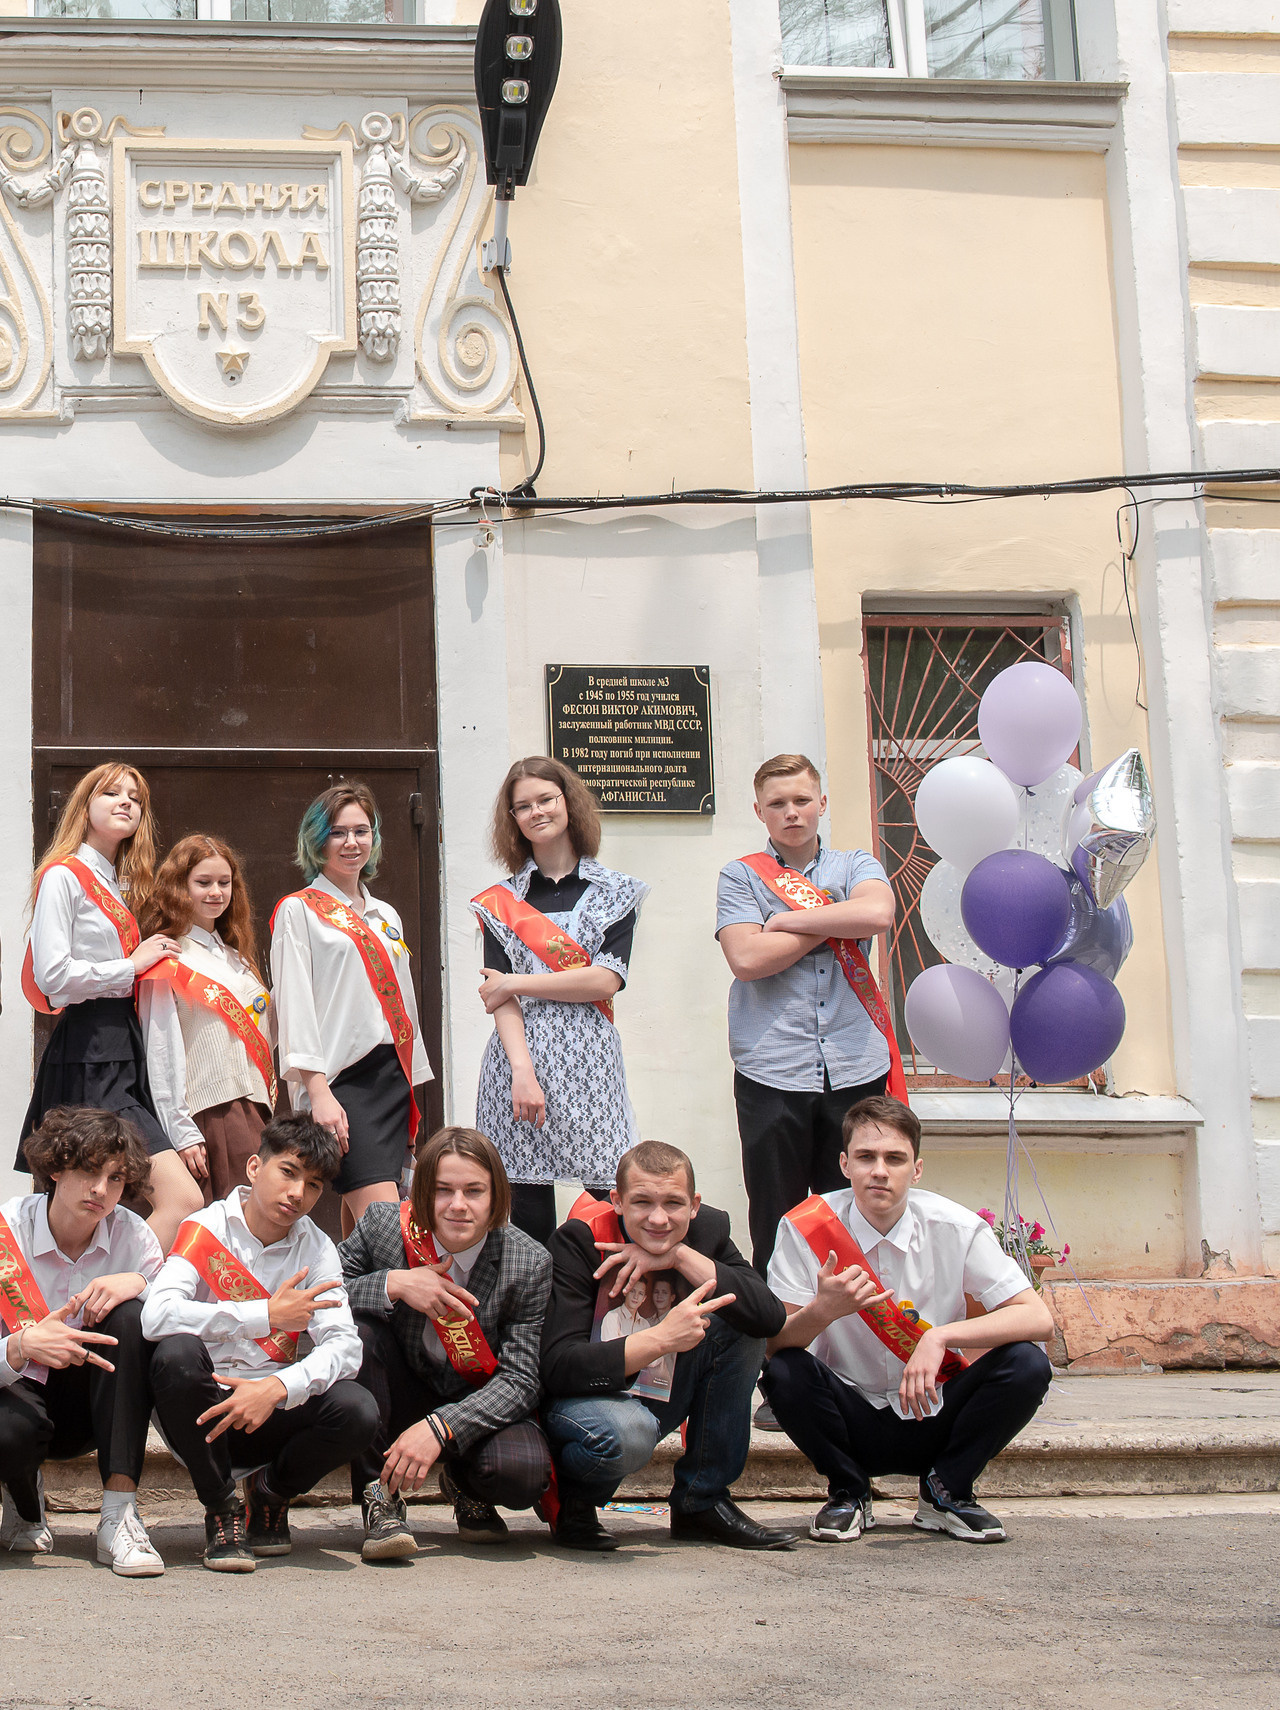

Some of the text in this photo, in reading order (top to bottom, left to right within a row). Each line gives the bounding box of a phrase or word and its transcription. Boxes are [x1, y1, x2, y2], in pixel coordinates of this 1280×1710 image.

[139, 180, 327, 213] СРЕДНЯЯ
[138, 230, 330, 270] ШКОЛА
[588, 676, 594, 685] В
[596, 676, 627, 687] средней
[657, 677, 669, 686] №3
[586, 691, 603, 700] 1945
[617, 691, 634, 700] 1955
[637, 693, 650, 701] год
[651, 693, 679, 703] учился
[563, 704, 698, 717] ФЕСЮН ВИКТОР АКИМОВИЧ,
[559, 719, 703, 731] заслуженный работник МВД СССР,
[589, 736, 673, 745] полковник милиции.
[563, 748, 700, 760] В 1982 году погиб при исполнении
[578, 764, 687, 775] интернационального долга
[650, 778, 695, 790] республике
[600, 791, 666, 801] АФГАНИСТАН.
[377, 981, 397, 997] 9
